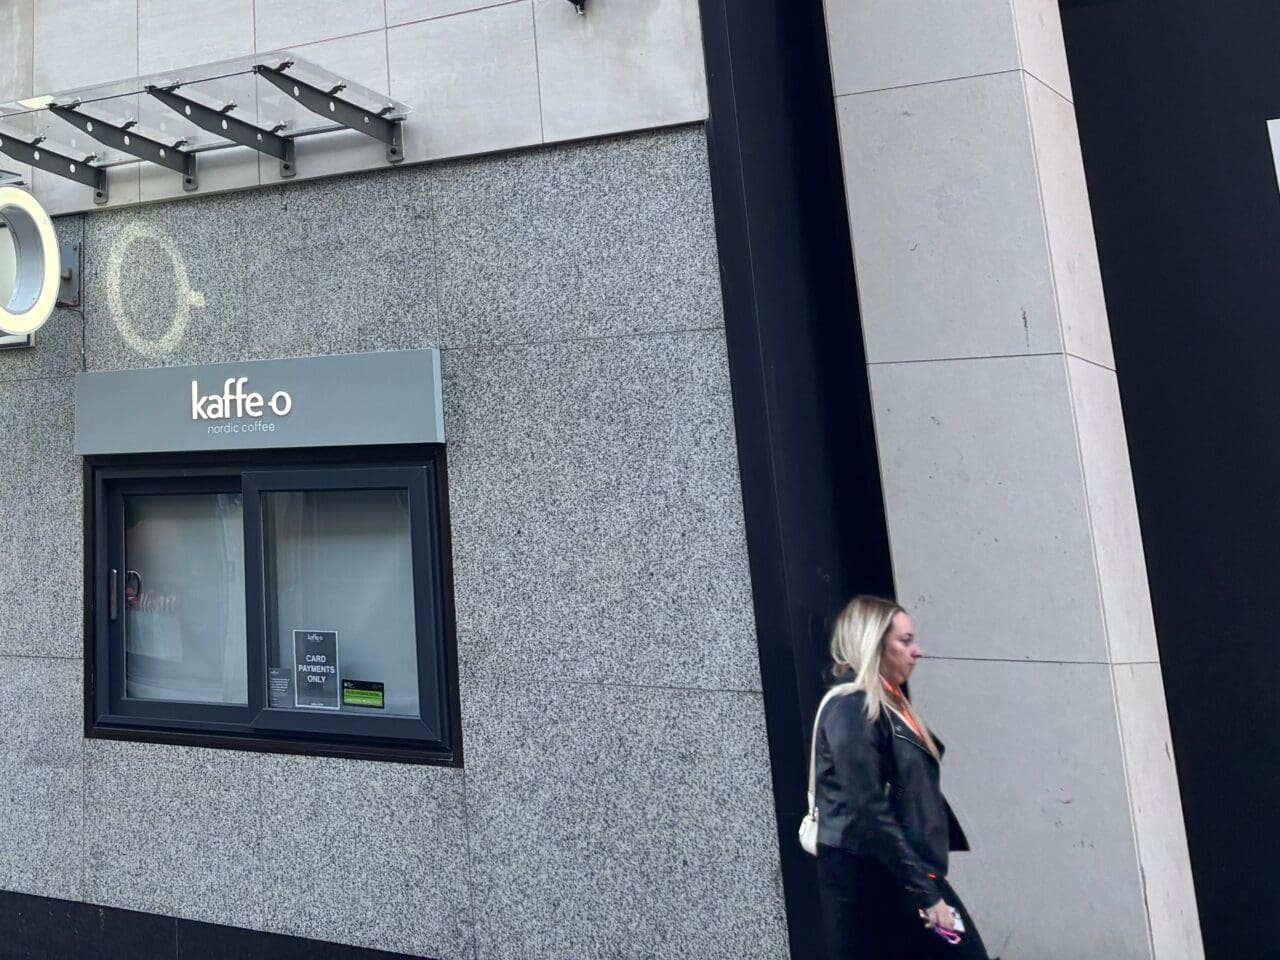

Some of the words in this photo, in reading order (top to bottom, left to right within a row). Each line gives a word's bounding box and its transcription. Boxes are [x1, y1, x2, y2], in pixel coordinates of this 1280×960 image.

[207, 422, 239, 434] nordic
[241, 421, 275, 433] coffee
[305, 655, 326, 663] CARD
[298, 664, 336, 674] PAYMENTS
[307, 675, 326, 683] ONLY
